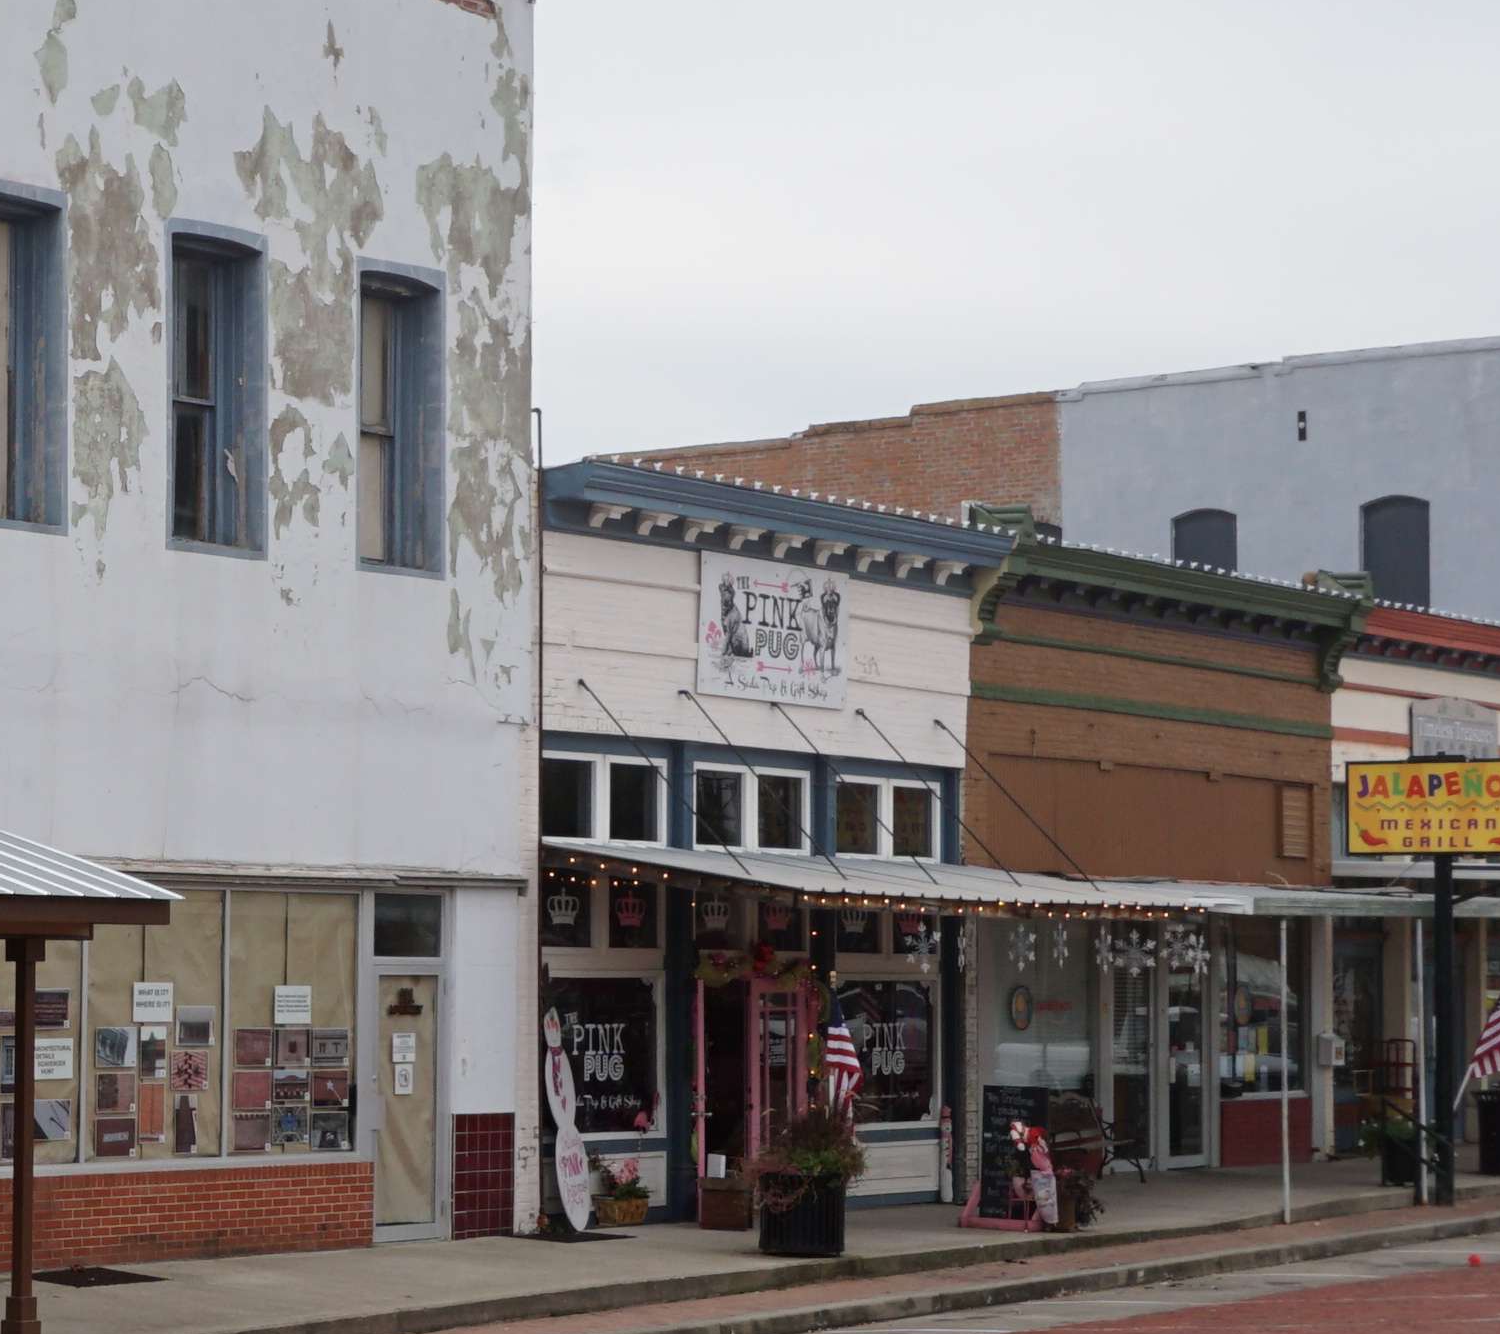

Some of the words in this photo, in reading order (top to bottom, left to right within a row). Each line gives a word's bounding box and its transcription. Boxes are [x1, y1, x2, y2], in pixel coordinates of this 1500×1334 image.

[736, 576, 750, 590] THE
[742, 591, 803, 631] PINK
[755, 628, 800, 660] PUG
[1380, 819, 1497, 831] MEXICAN
[1402, 836, 1473, 848] GRILL
[572, 1023, 626, 1056] PINK
[862, 1022, 906, 1052] PINK
[583, 1054, 625, 1082] PUG
[871, 1050, 906, 1076] PUG
